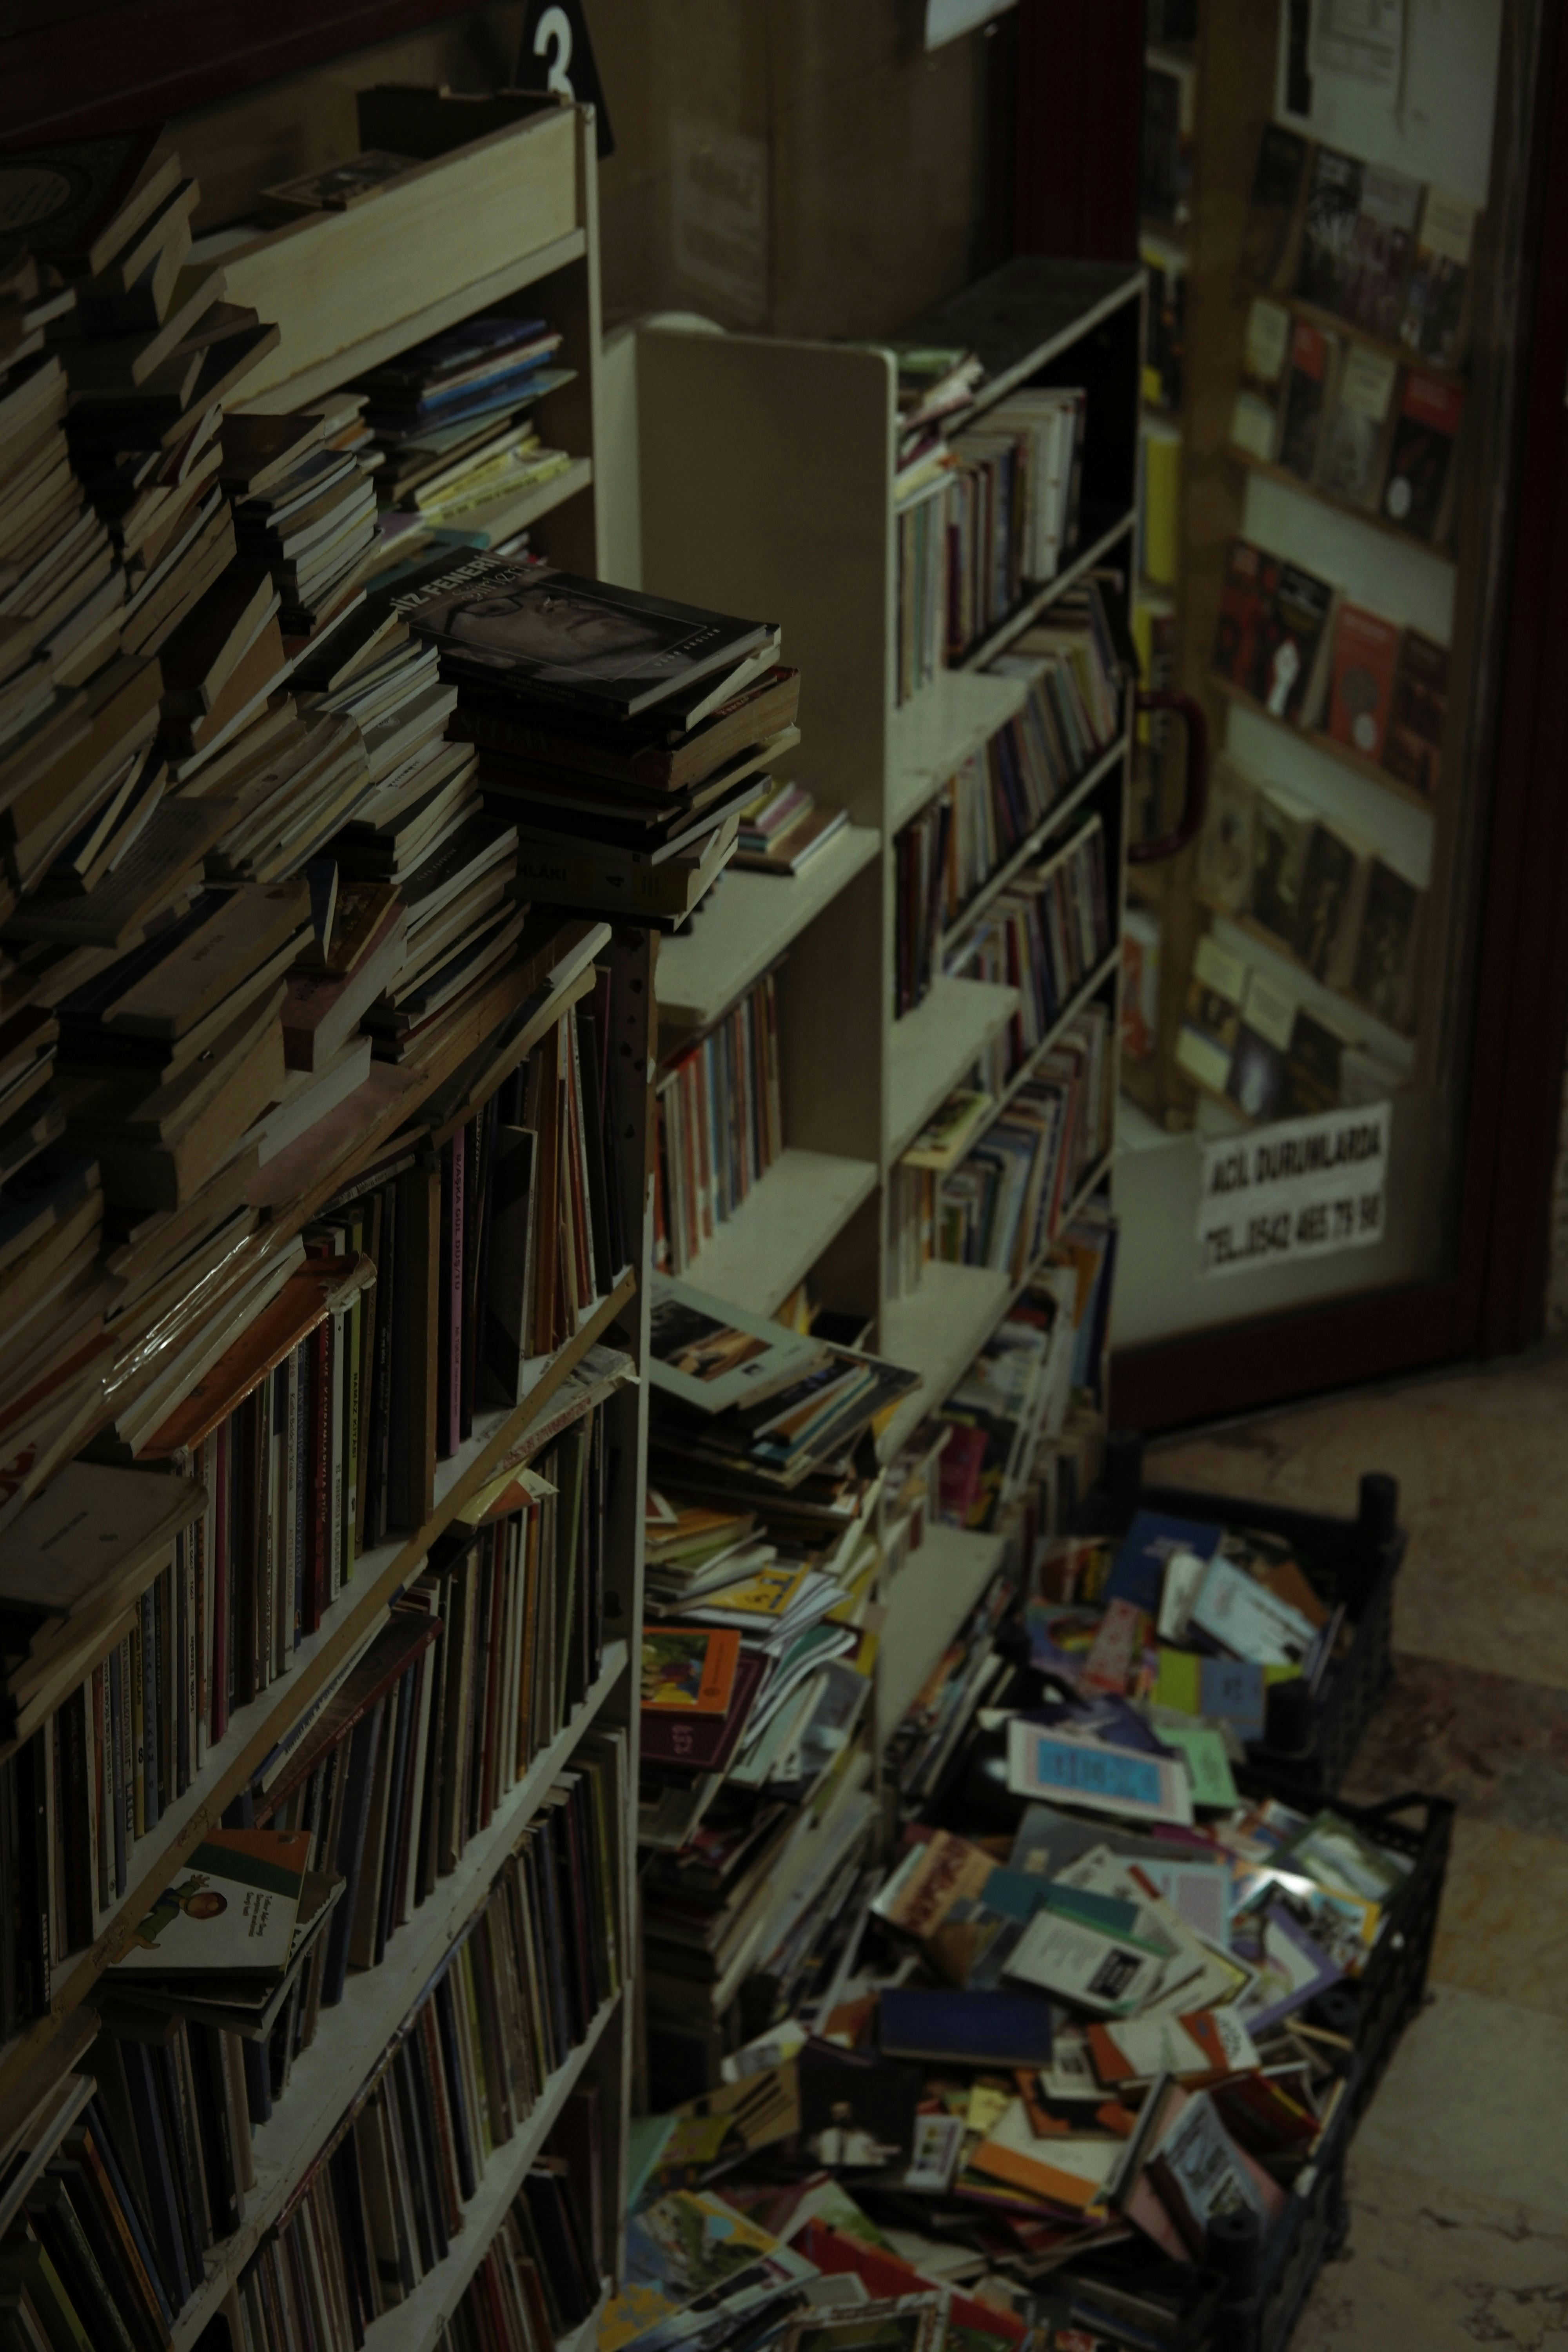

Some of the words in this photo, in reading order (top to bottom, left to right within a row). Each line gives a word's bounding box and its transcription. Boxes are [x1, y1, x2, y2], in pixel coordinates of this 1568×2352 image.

[420, 554, 501, 596] FENERİ
[517, 864, 566, 881] HLÂKI
[138, 1746, 143, 1764] 8
